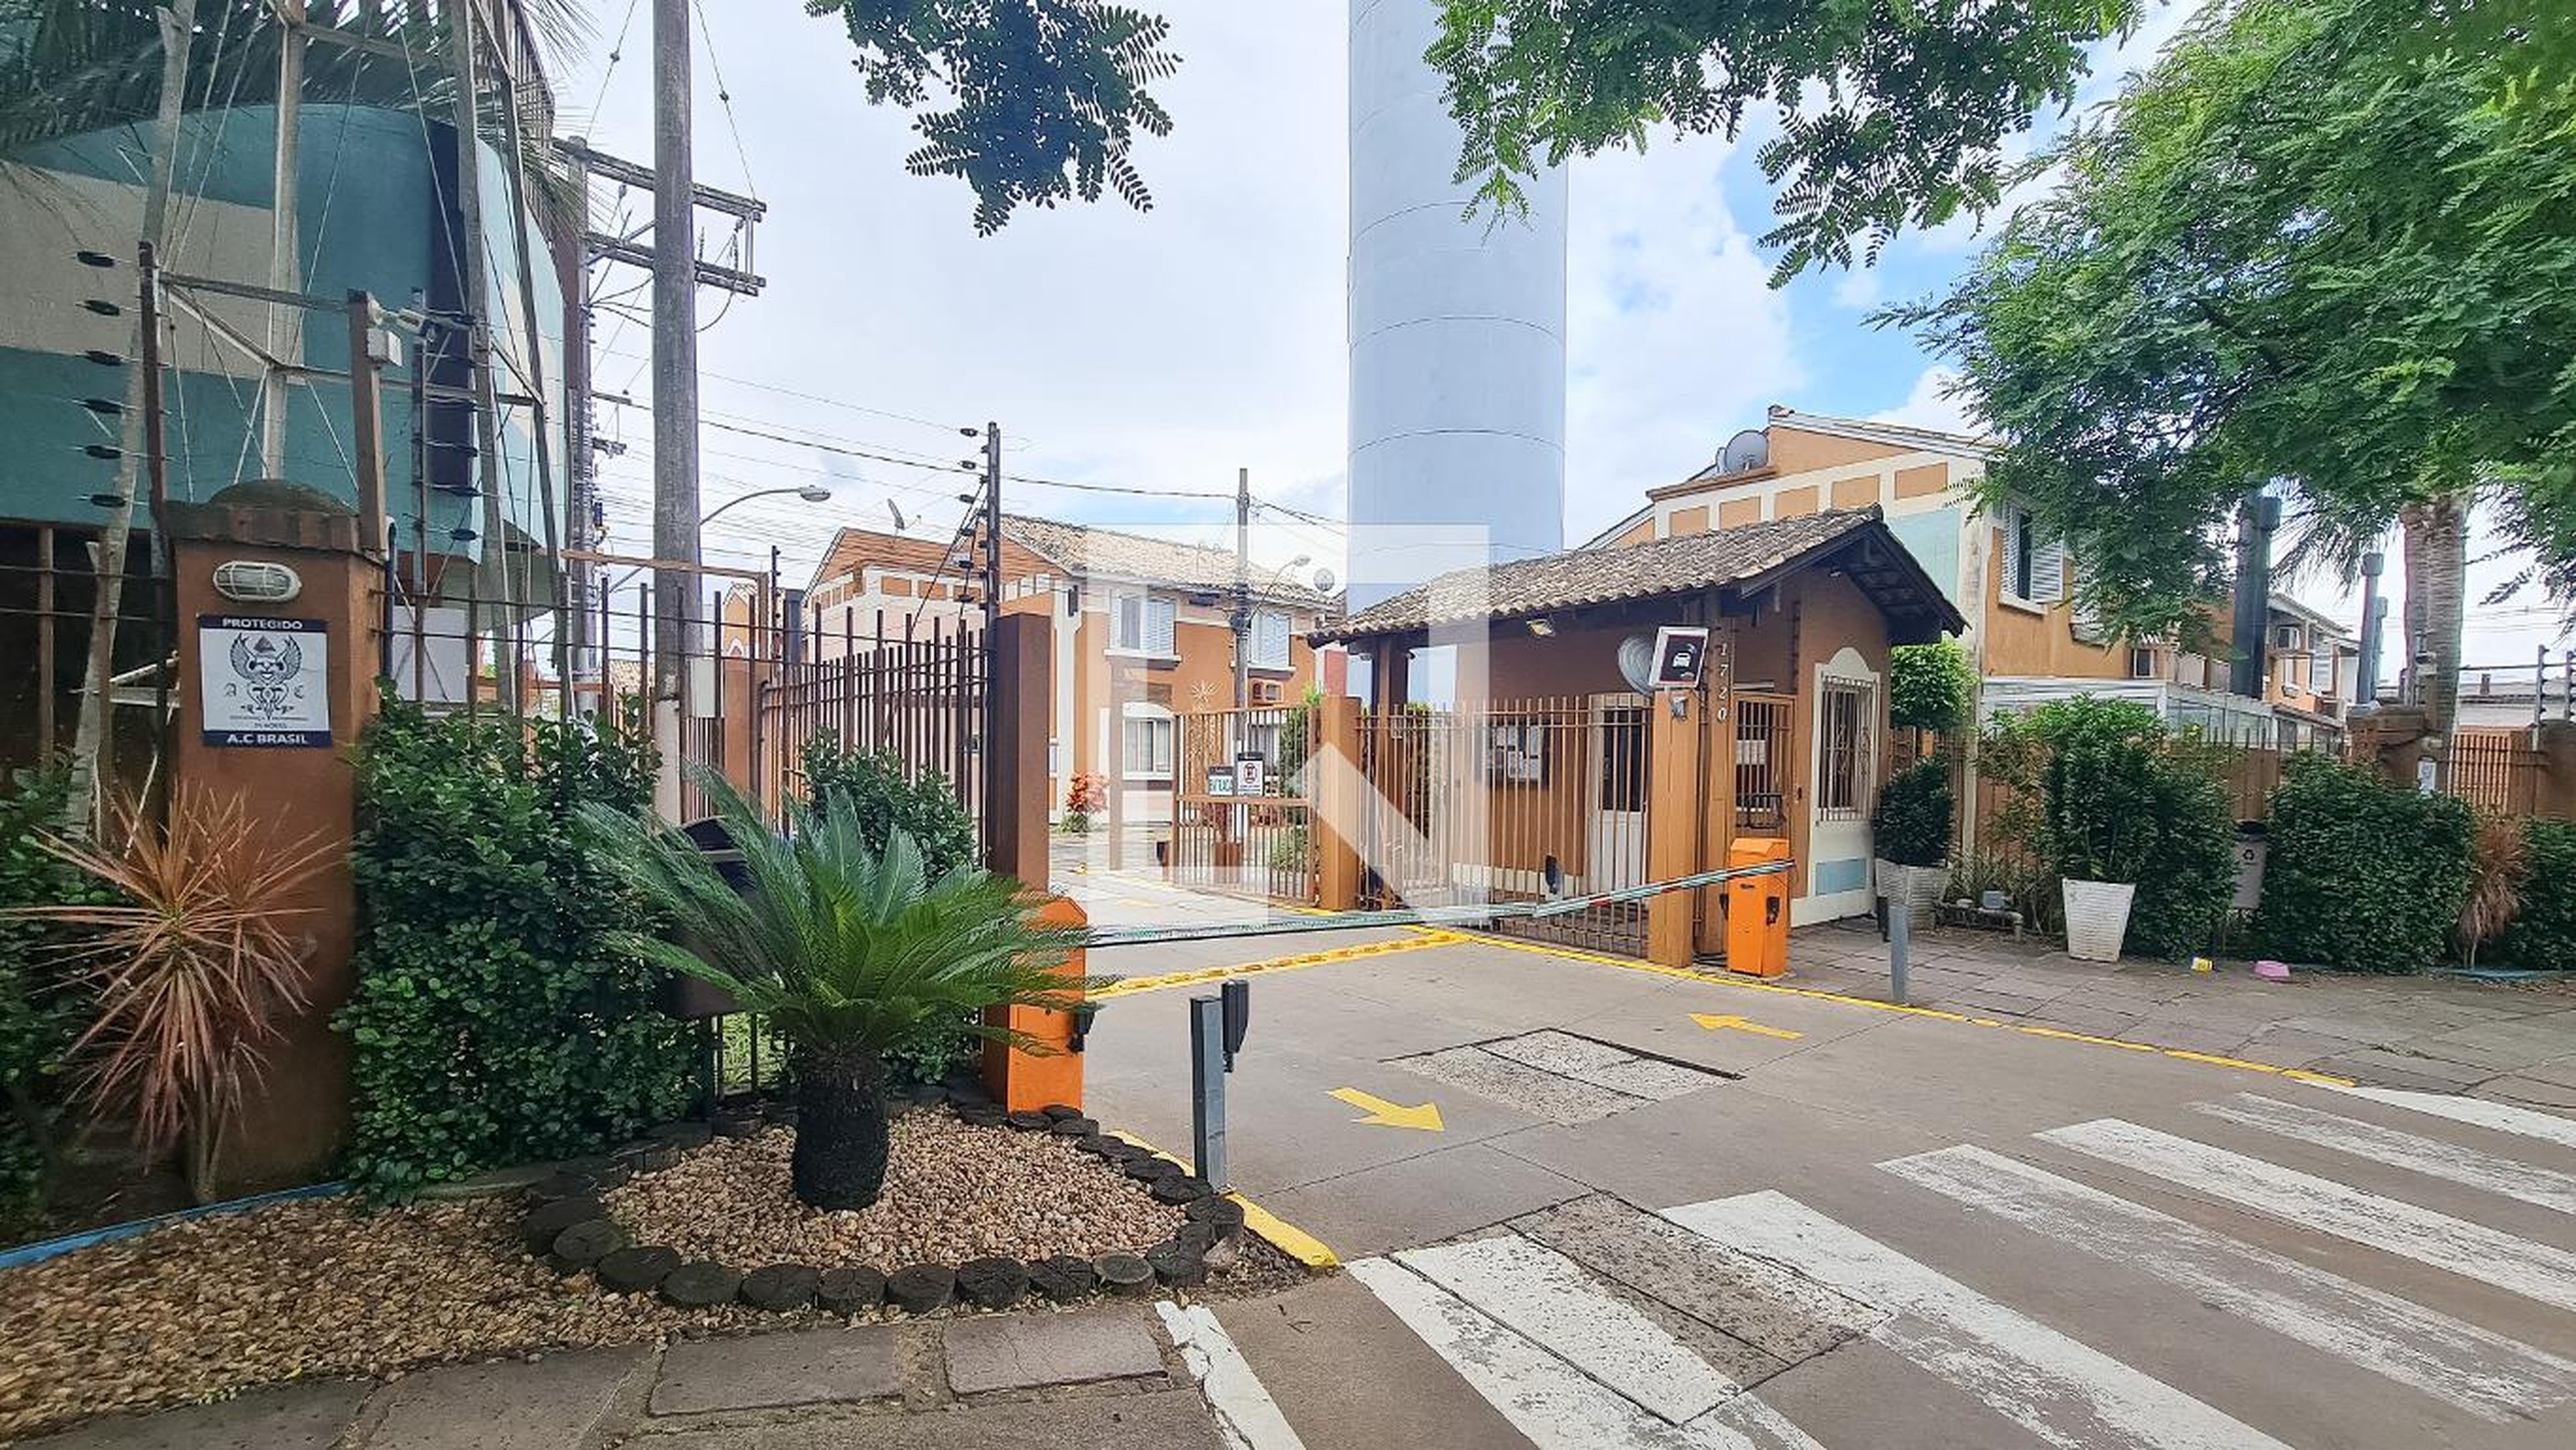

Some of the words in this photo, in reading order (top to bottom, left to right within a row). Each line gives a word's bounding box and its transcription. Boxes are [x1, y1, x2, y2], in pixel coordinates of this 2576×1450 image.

[222, 617, 303, 629] PROTEGIDO
[1718, 643, 1729, 721] 1720
[227, 733, 254, 744] A.C
[257, 733, 308, 745] BRASIL
